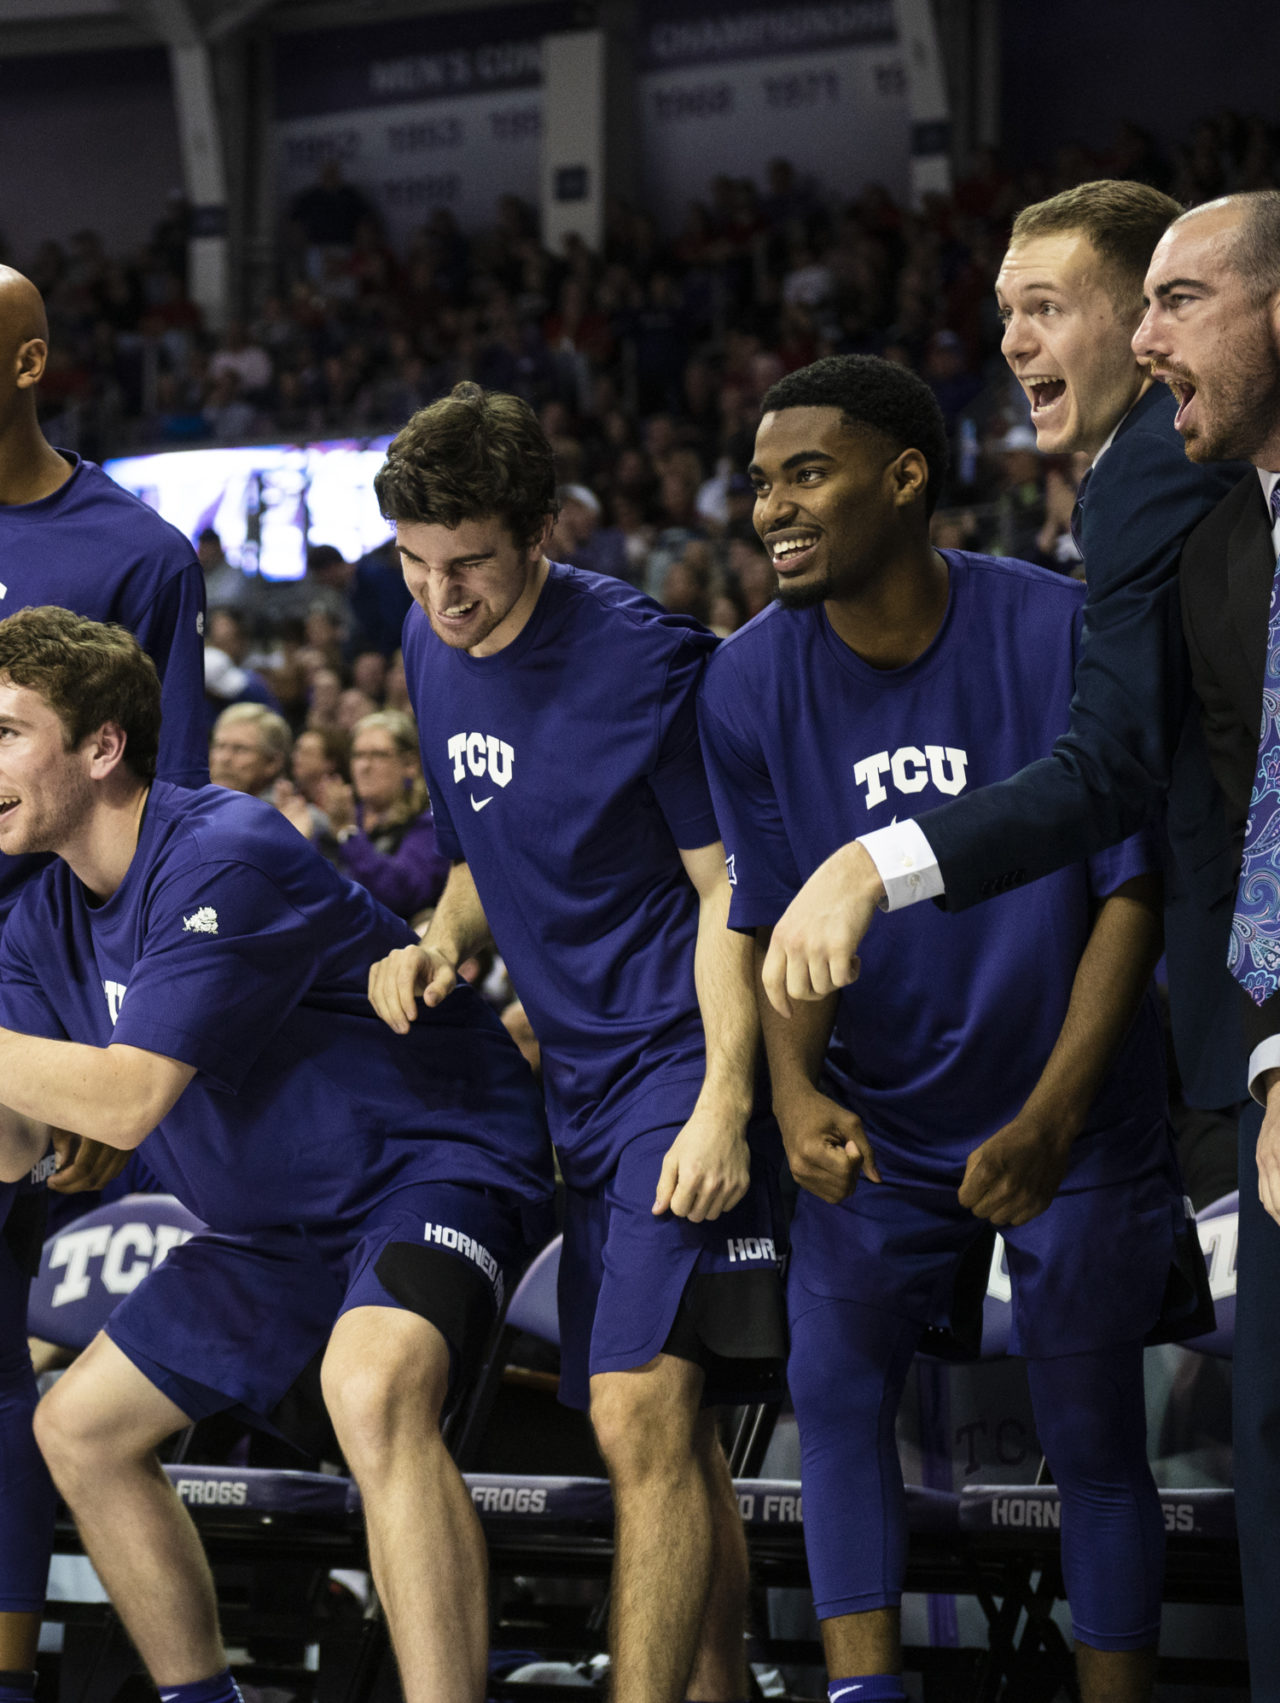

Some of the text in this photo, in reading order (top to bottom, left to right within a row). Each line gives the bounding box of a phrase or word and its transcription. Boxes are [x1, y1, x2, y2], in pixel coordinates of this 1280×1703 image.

[649, 4, 898, 57] CHAMPIONSHI
[448, 732, 514, 788] TCU
[854, 745, 968, 810] TCU
[424, 1222, 498, 1283] HORNED
[727, 1237, 778, 1263] HOR
[956, 1416, 1028, 1477] TC
[176, 1479, 248, 1505] FROGS
[471, 1487, 548, 1513] FROGS
[991, 1500, 1061, 1528] HORN
